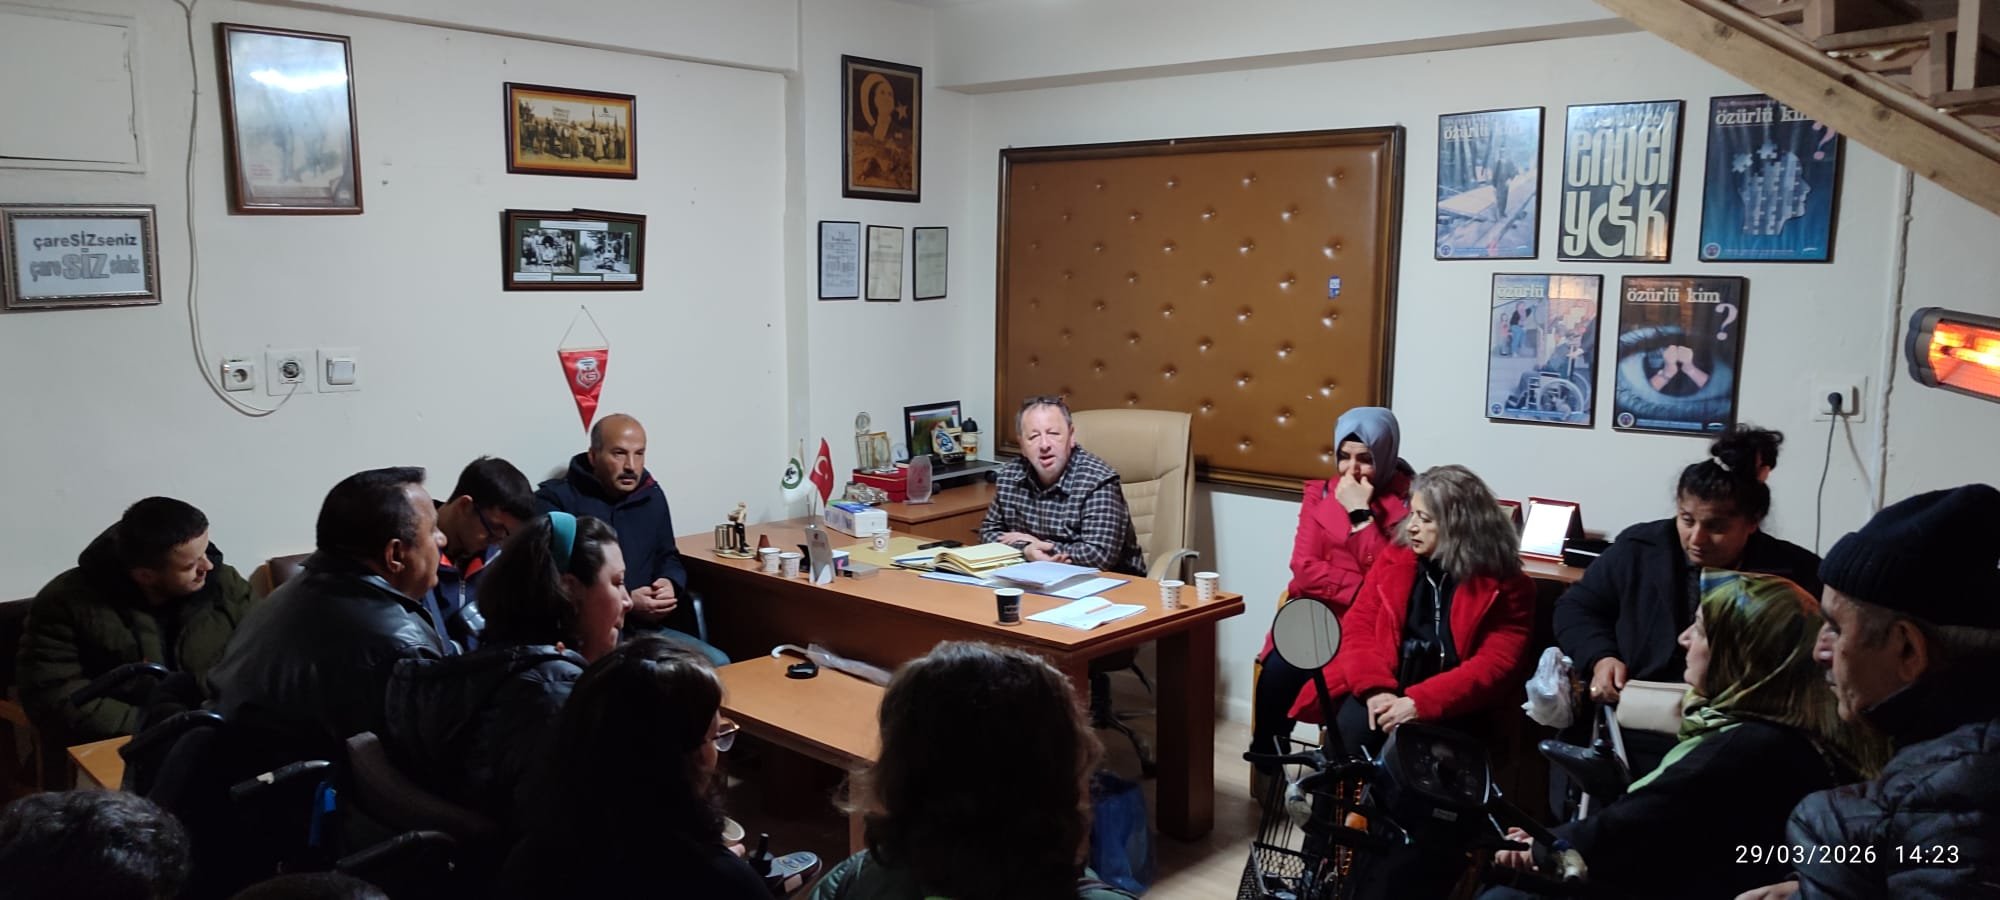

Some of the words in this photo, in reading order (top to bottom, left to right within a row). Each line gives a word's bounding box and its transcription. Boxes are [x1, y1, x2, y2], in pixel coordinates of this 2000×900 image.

[1715, 106, 1774, 125] özürlü
[1568, 111, 1675, 197] engel
[33, 230, 138, 251] çareSİZseniz
[1497, 283, 1545, 299] özürlü
[1626, 287, 1680, 303] özürlü
[1686, 286, 1721, 304] kim
